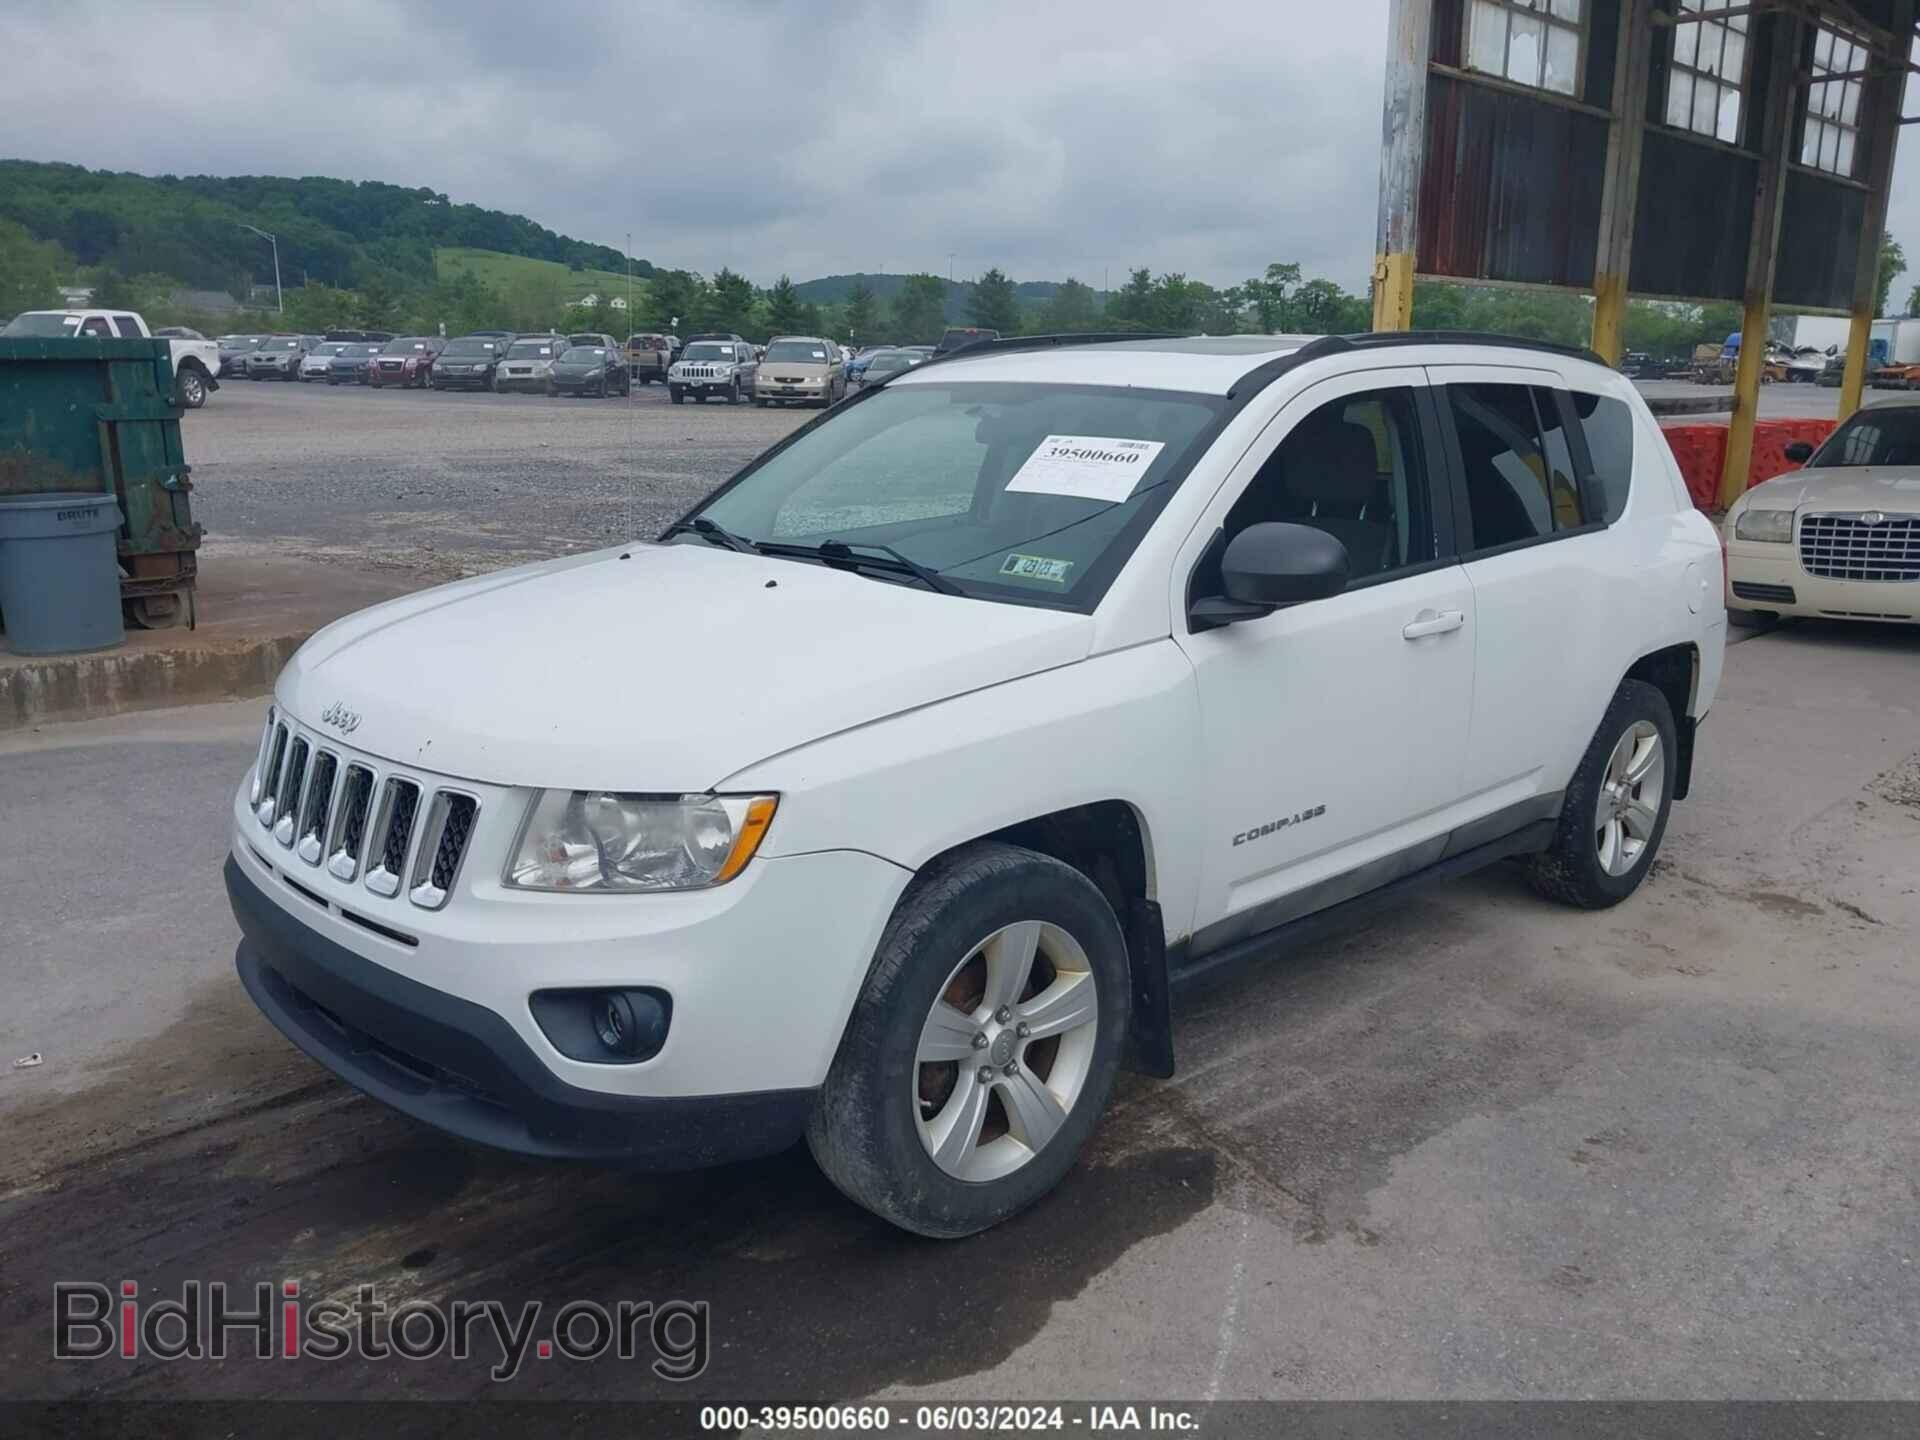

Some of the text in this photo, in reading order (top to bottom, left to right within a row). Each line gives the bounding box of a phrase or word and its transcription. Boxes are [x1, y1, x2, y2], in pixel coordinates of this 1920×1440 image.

[1044, 447, 1140, 464] 39500660
[321, 700, 362, 736] Jeep
[1232, 804, 1326, 846] COMPASS
